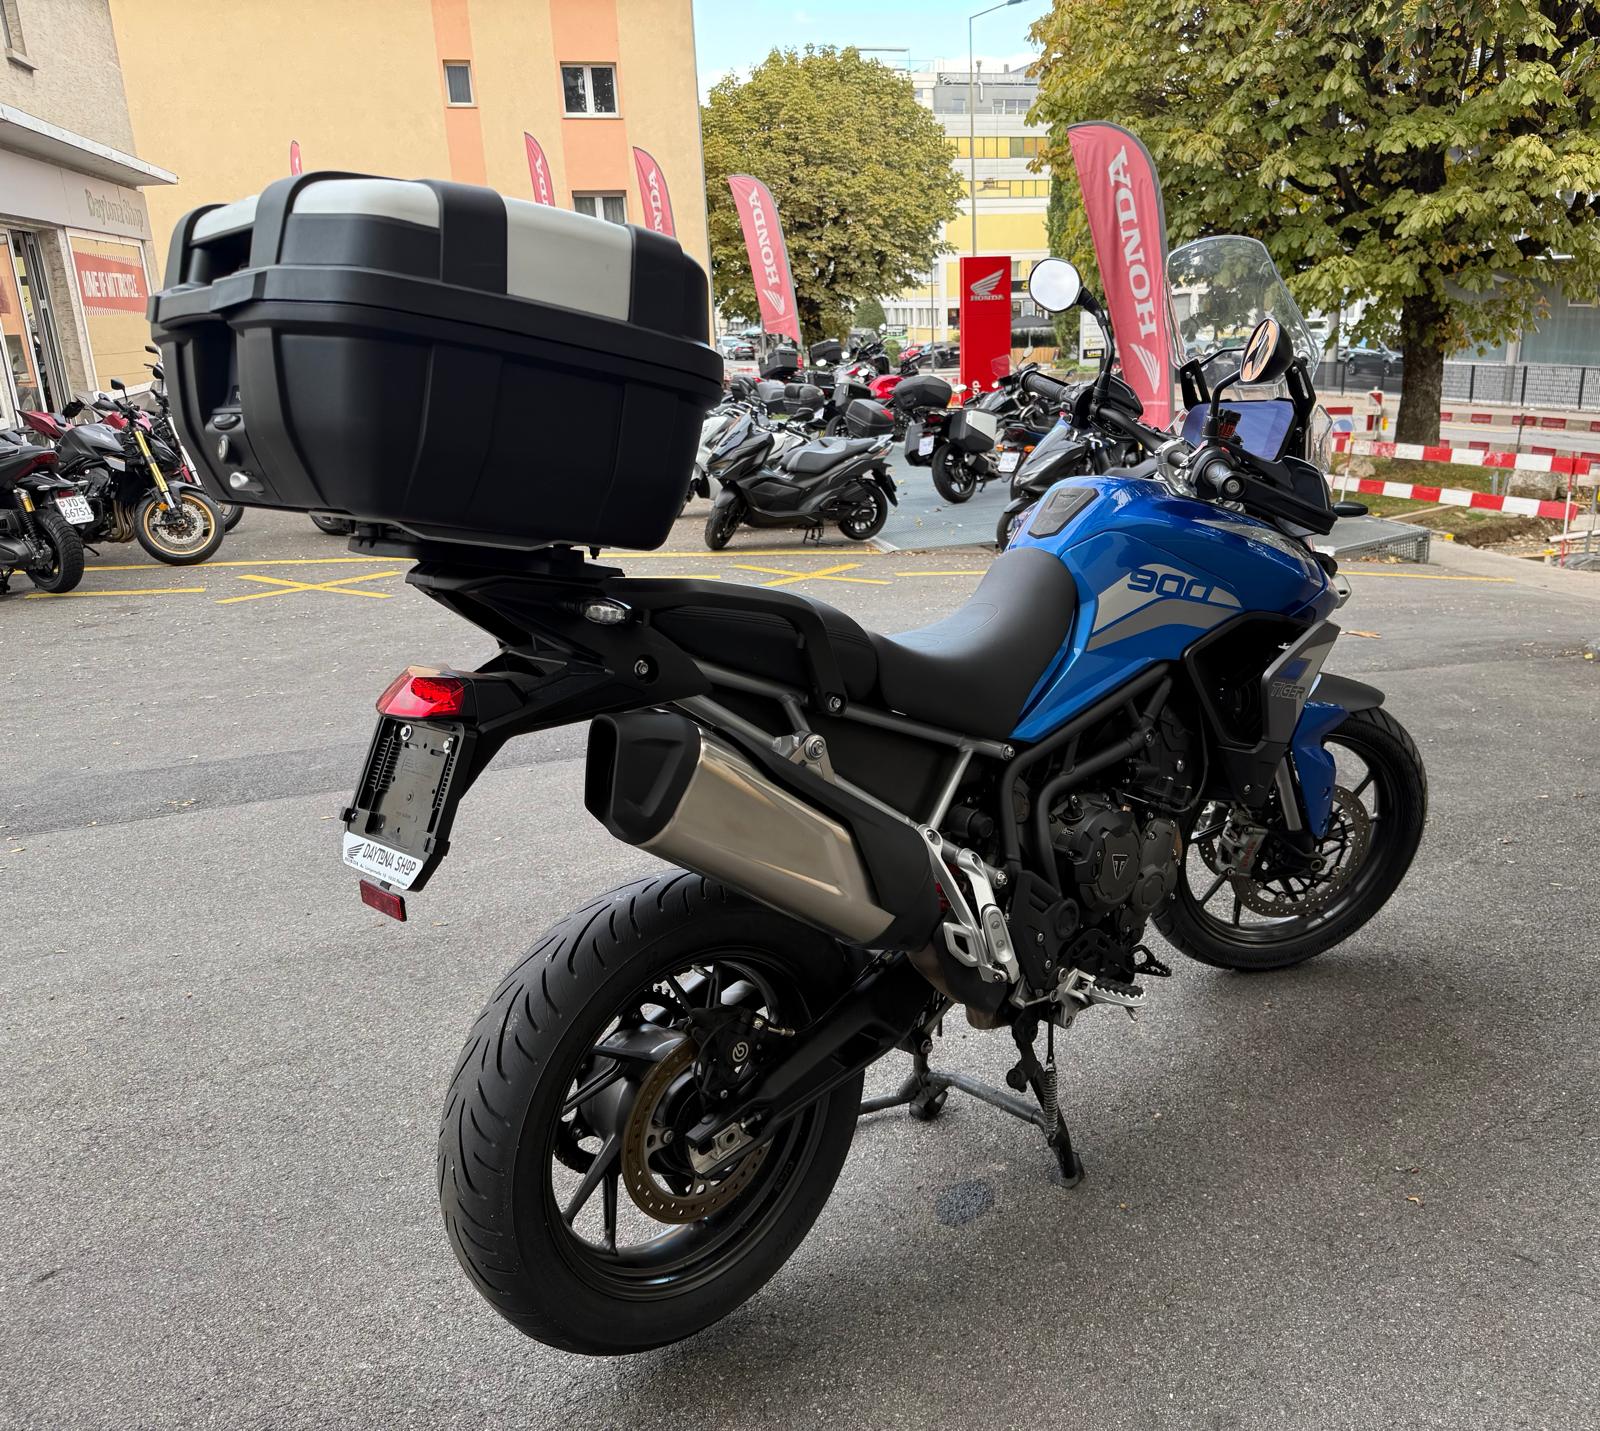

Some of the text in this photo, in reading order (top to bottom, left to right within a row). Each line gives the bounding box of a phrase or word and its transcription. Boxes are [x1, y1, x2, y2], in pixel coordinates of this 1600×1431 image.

[748, 186, 781, 286] HONDA
[1107, 145, 1157, 339] HONDA
[970, 294, 1005, 302] HONDA
[66, 498, 78, 507] VD
[1127, 567, 1213, 601] 900
[1270, 681, 1306, 699] TIGER
[363, 844, 395, 869] DAYTONA
[394, 855, 417, 876] SHOP
